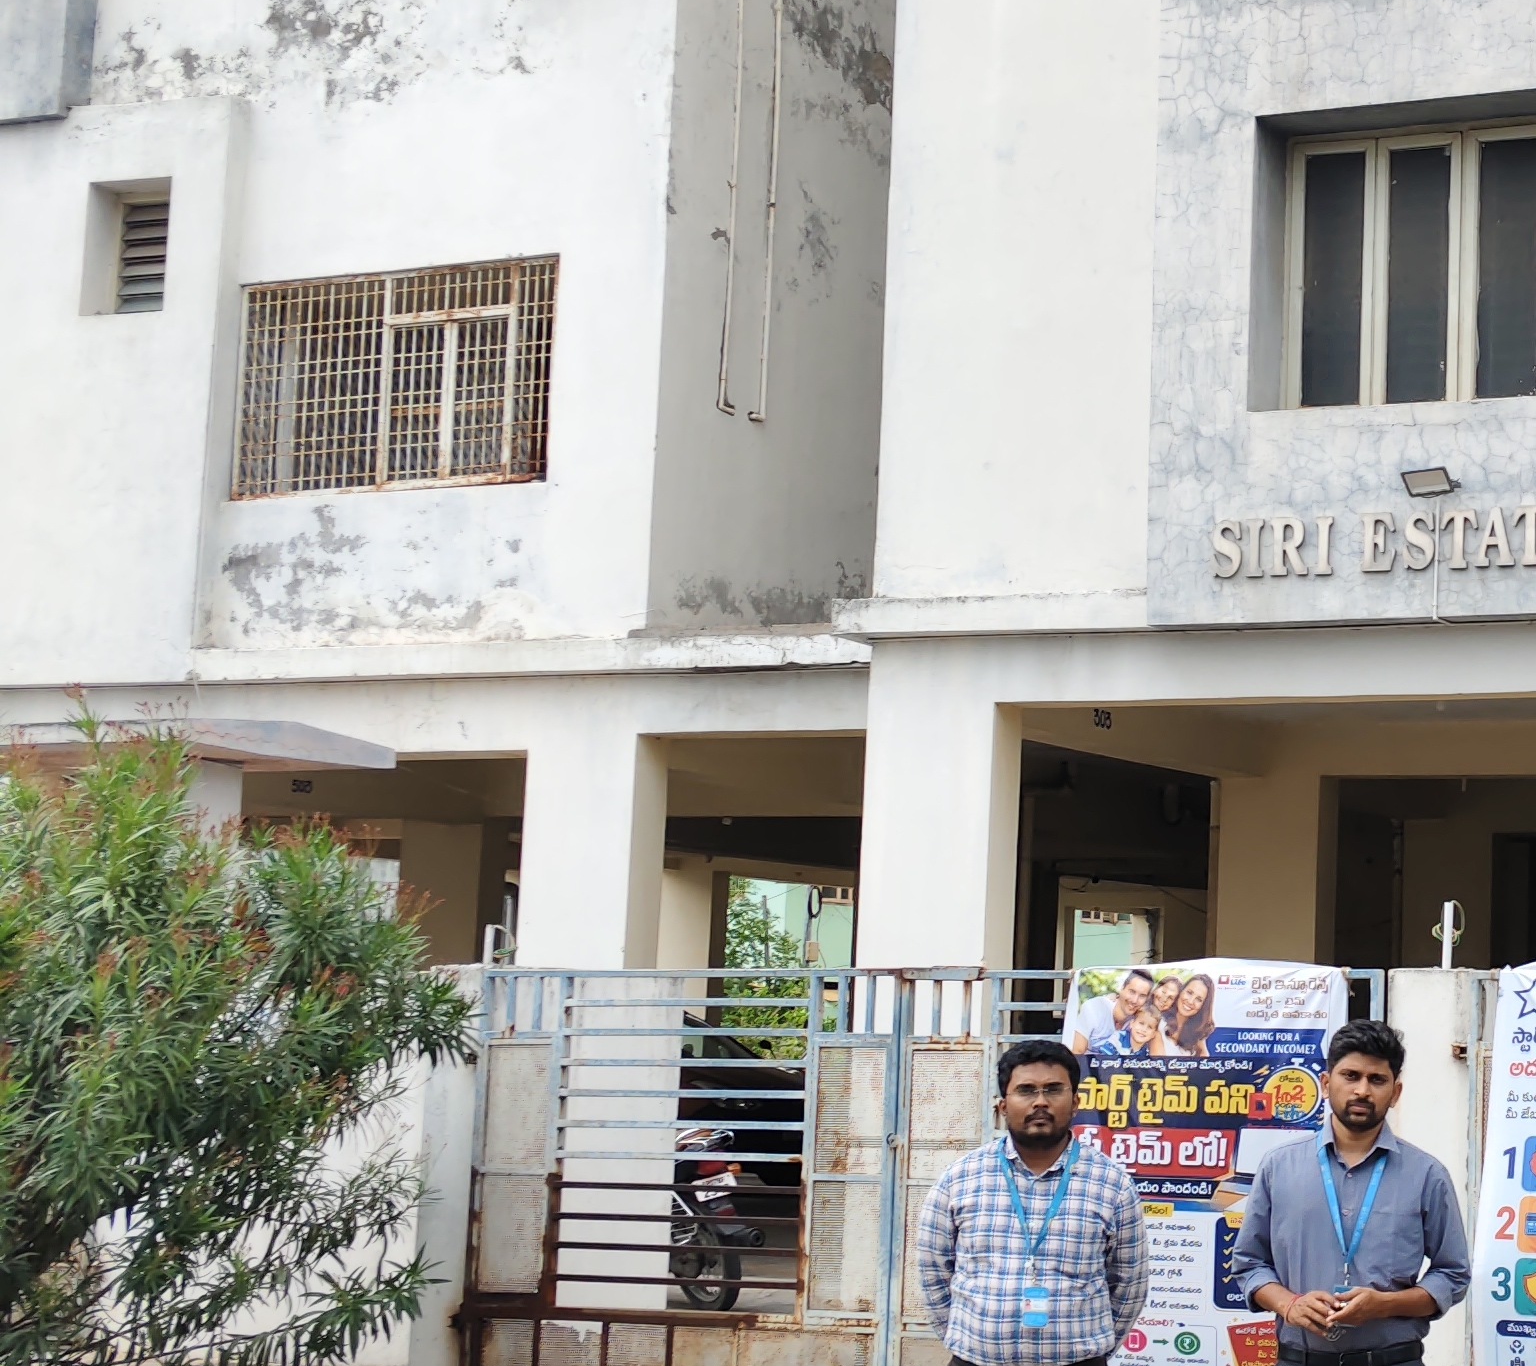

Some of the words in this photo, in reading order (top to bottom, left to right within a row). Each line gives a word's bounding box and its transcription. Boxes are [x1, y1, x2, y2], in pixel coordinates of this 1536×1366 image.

[1212, 515, 1334, 579] SIRI
[1215, 1042, 1271, 1054] SECONDARY
[1273, 1044, 1317, 1055] INCOME?
[1238, 1031, 1274, 1041] LOOKING
[1275, 1032, 1293, 1042] FOR
[1294, 1033, 1300, 1041] A
[1137, 1075, 1198, 1124] టైమ్
[1502, 1146, 1517, 1179] 1
[1494, 1206, 1516, 1240] 2
[1491, 1266, 1511, 1302] 3
